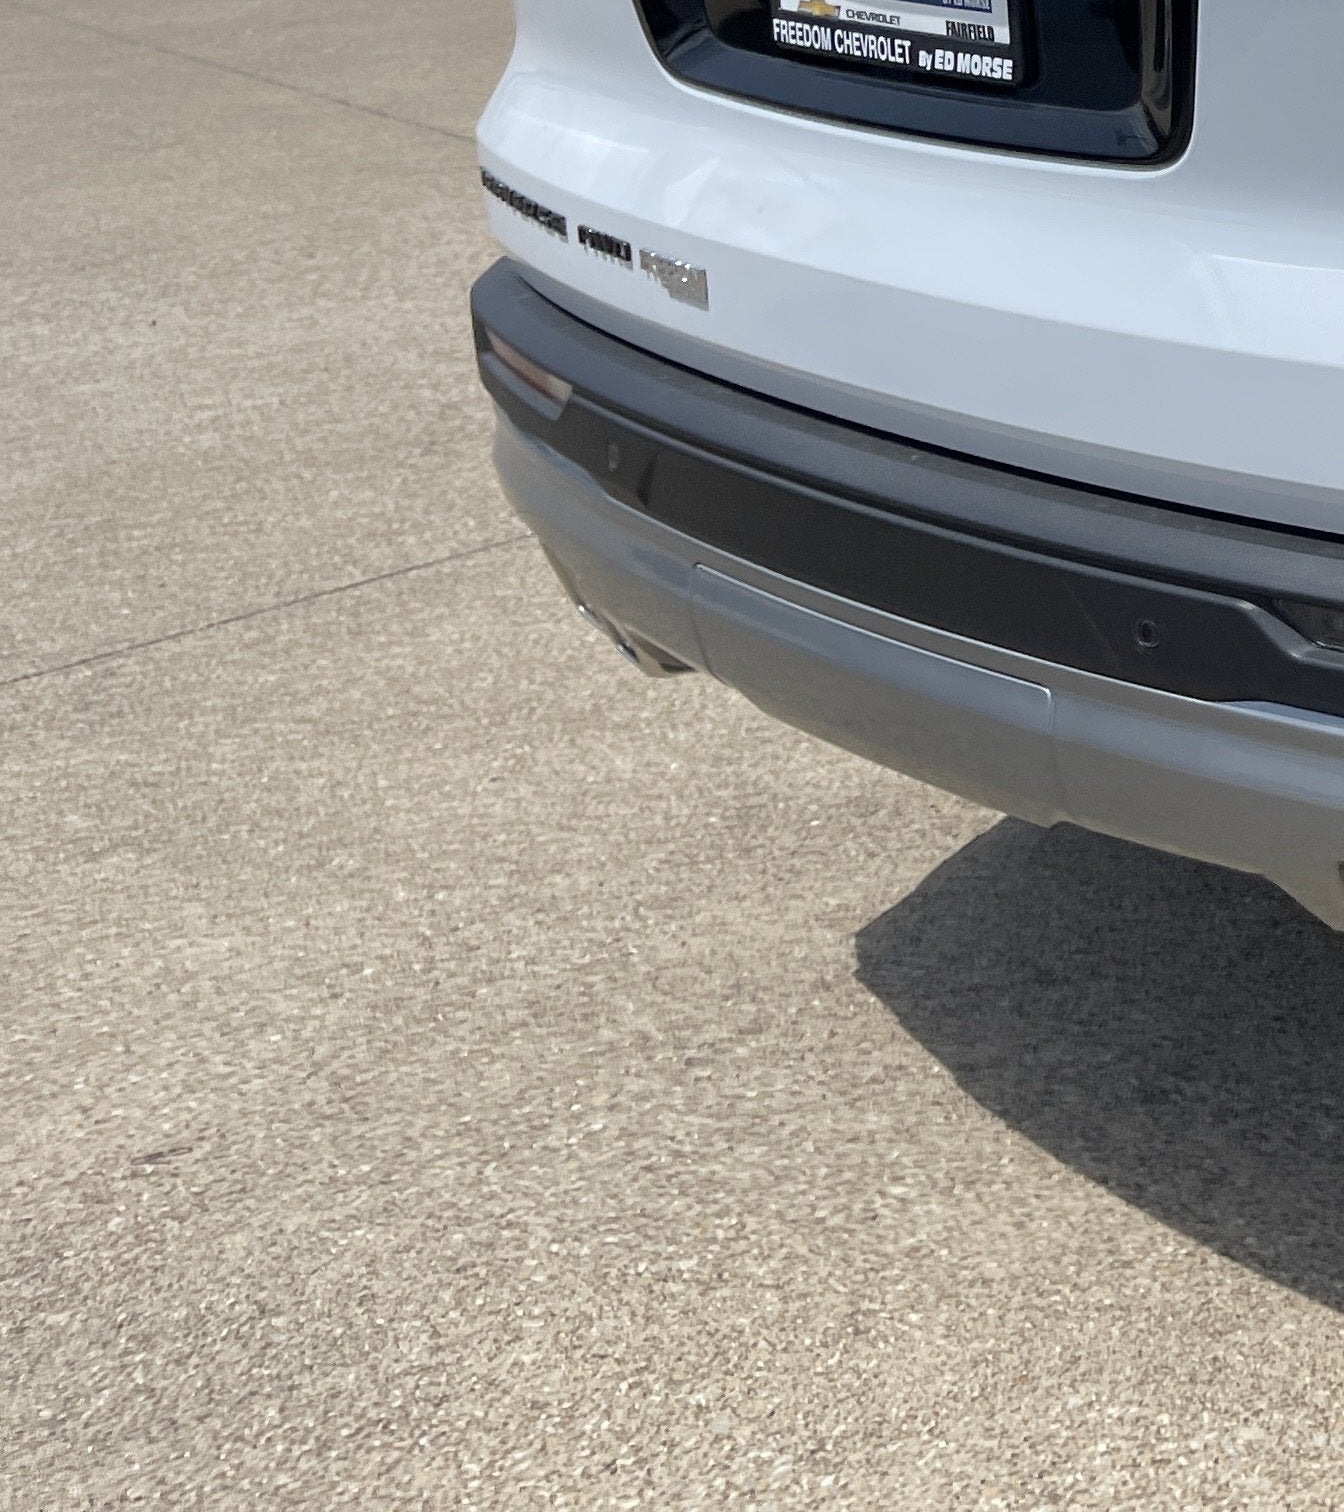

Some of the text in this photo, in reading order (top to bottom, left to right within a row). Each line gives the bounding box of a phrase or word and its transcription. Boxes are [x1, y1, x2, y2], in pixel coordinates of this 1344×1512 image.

[846, 8, 901, 26] CHEVROLET
[945, 20, 995, 42] FAIRFIELD
[772, 18, 831, 51] FREEDOM
[835, 28, 911, 65] CHEVROLET
[934, 48, 953, 70] ED
[956, 52, 1013, 80] MORSE
